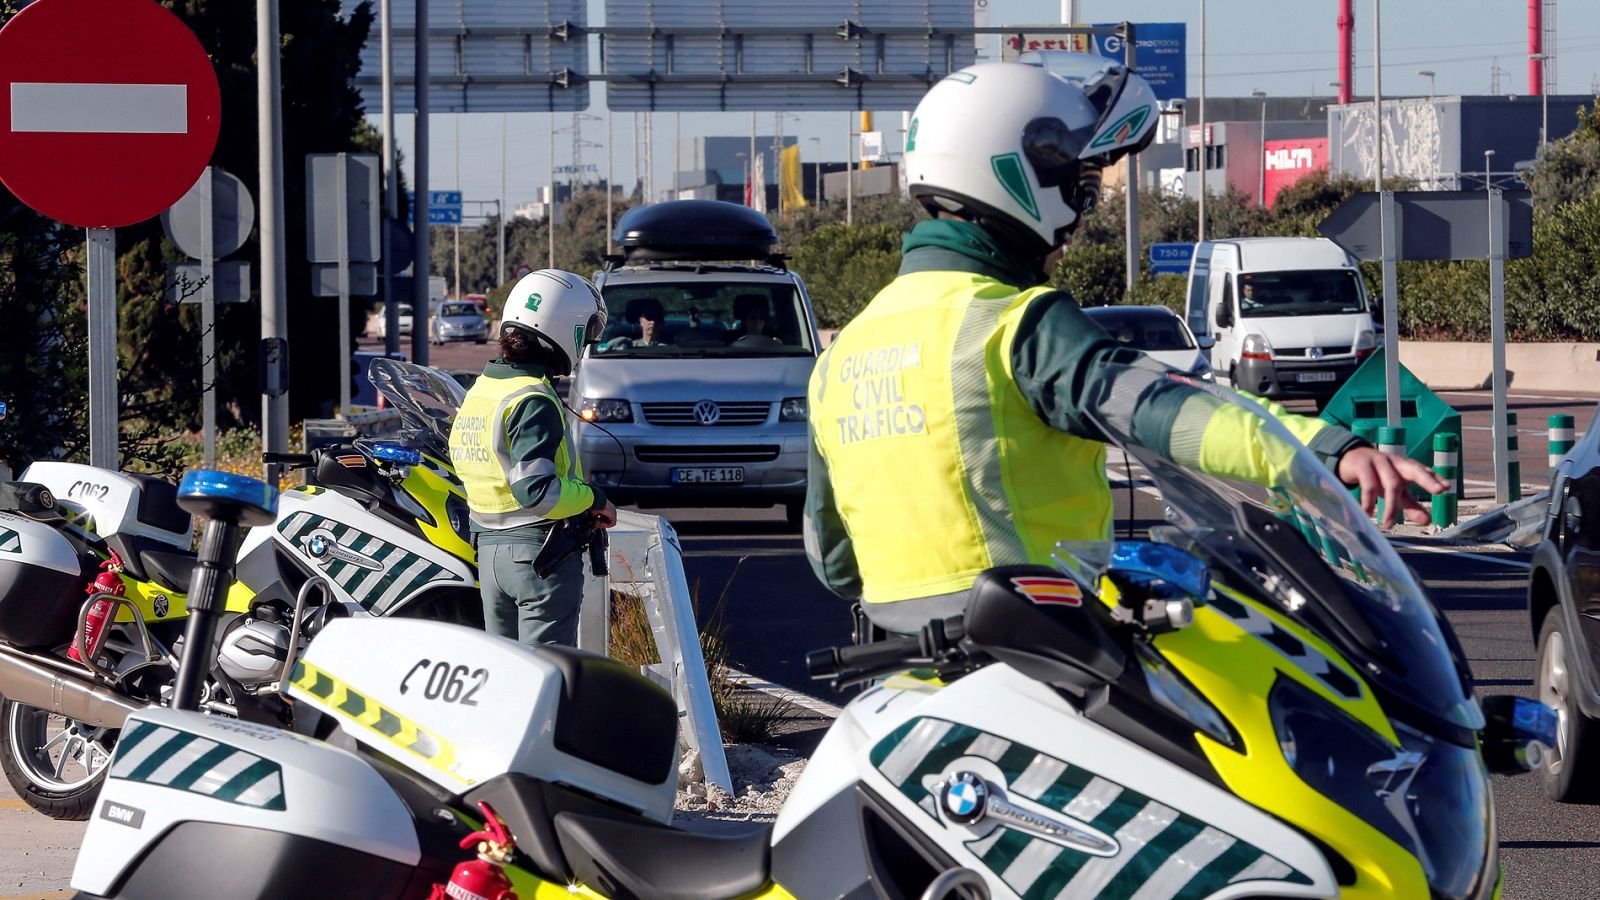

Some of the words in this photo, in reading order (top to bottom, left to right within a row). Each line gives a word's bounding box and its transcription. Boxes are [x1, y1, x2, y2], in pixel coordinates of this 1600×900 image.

[1266, 148, 1312, 170] HILTI
[1160, 249, 1178, 257] 750
[840, 342, 921, 383] GUARDIA
[853, 375, 904, 410] CIVIL
[455, 416, 487, 432] GUARDIA
[836, 404, 926, 446] TRAFICO
[461, 431, 482, 447] CIVIL
[450, 447, 490, 463] TRAFICO
[678, 470, 692, 481] CE
[703, 470, 716, 481] TE
[720, 469, 742, 481] 118
[424, 661, 489, 706] 062
[108, 805, 134, 822] BMW
